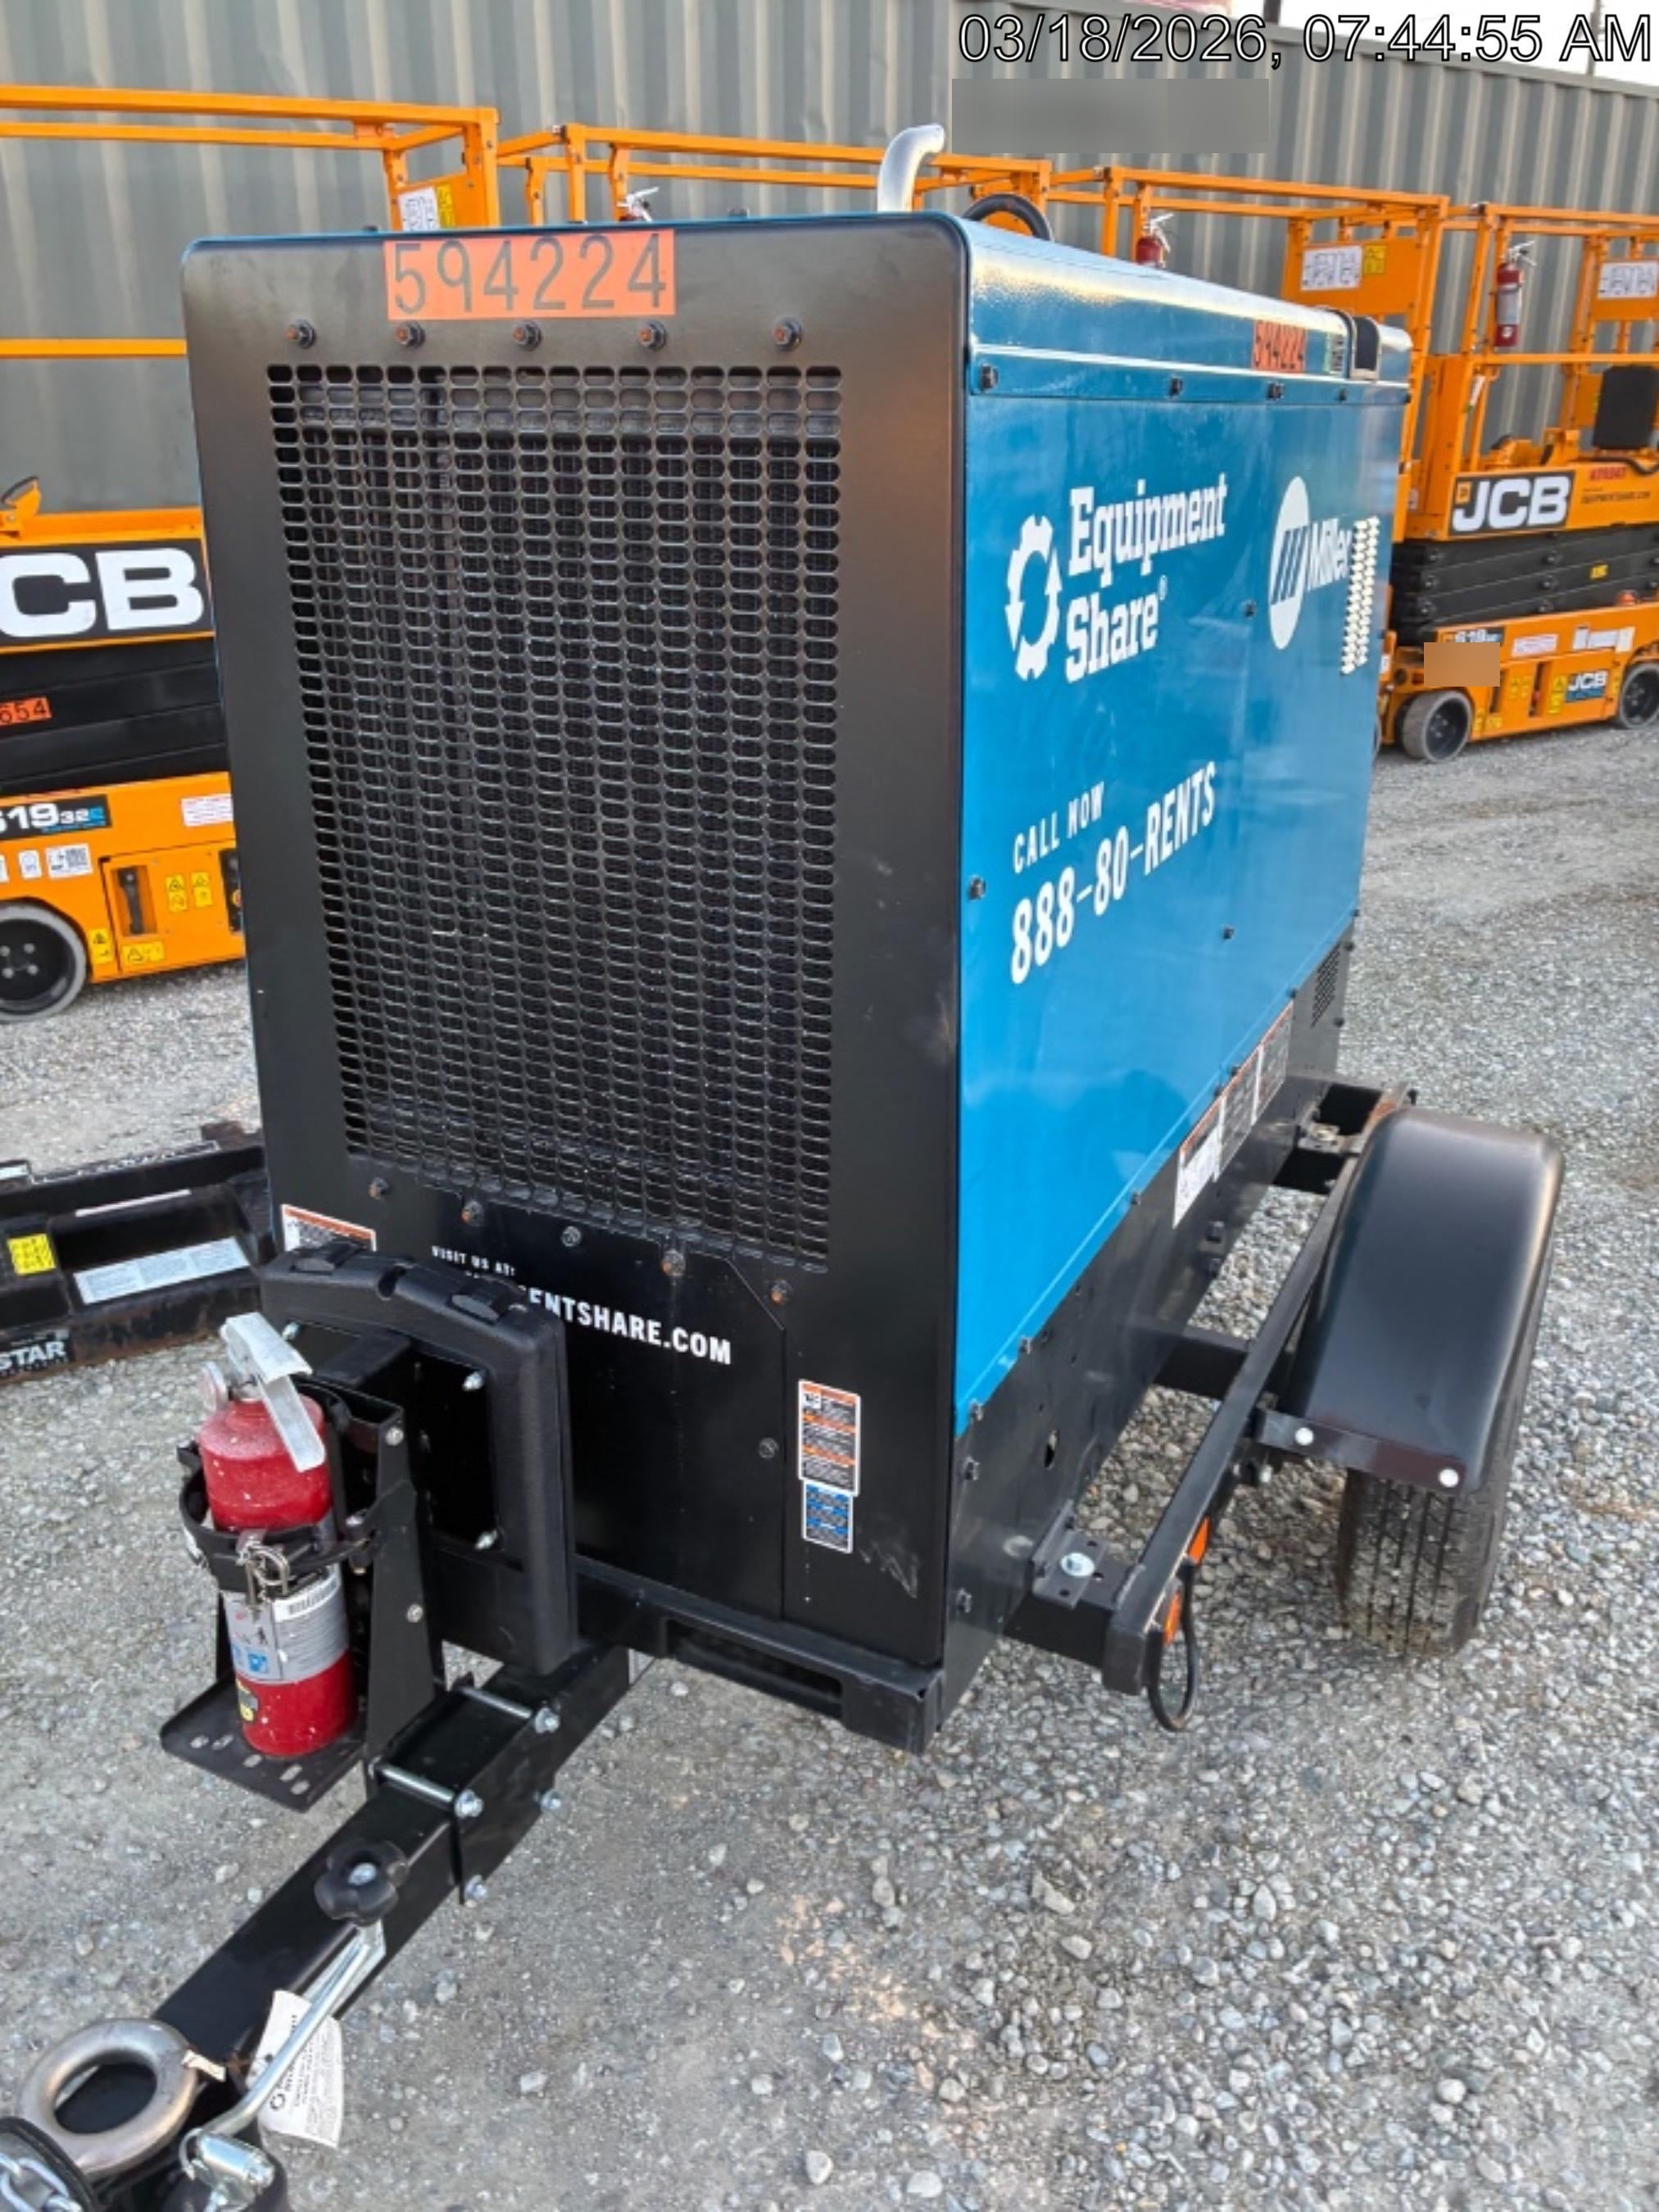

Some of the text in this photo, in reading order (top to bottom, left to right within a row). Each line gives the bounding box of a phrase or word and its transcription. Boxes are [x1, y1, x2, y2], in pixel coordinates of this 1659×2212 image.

[393, 233, 667, 315] 594224
[1068, 472, 1227, 588] Equipment
[1453, 475, 1571, 533] JCB
[1308, 516, 1352, 592] Miller
[1567, 670, 1609, 692] JCB
[1013, 781, 1104, 874] CALL NOW
[1010, 760, 1216, 985] 888-80-RENTS
[432, 1245, 467, 1264] VISIT
[471, 1254, 490, 1270] US
